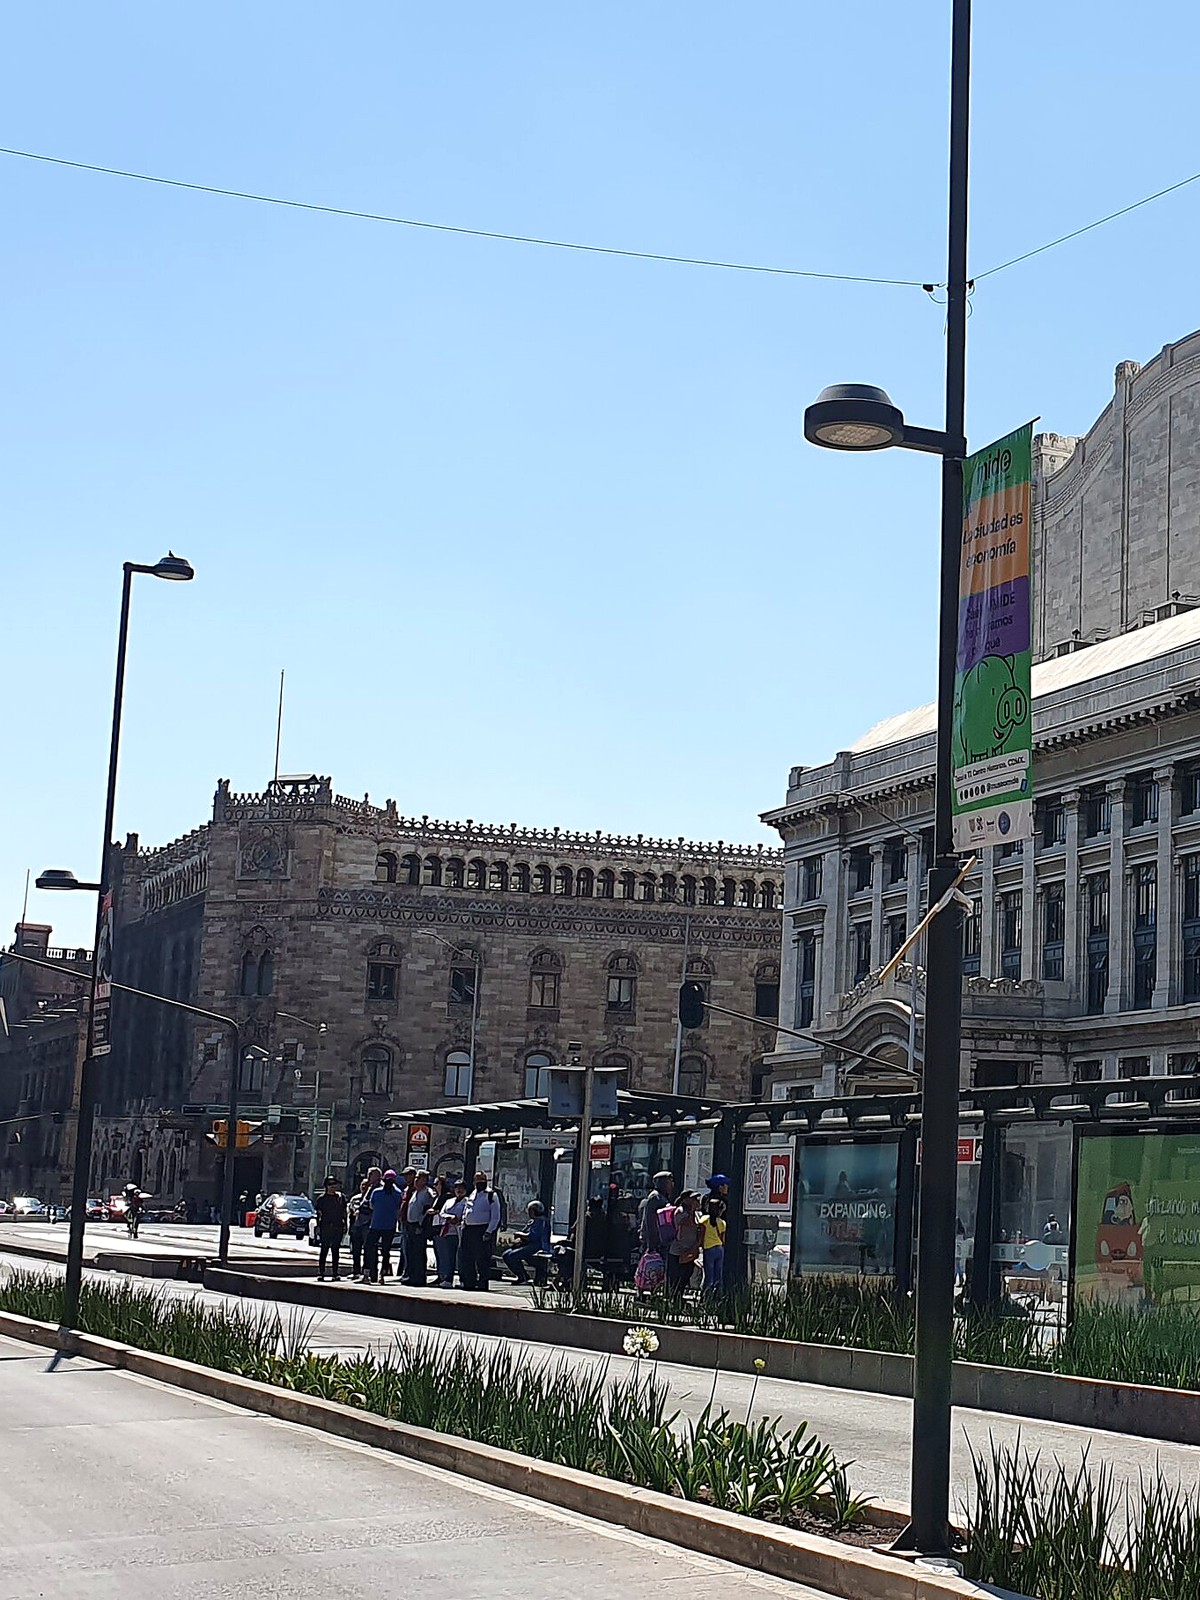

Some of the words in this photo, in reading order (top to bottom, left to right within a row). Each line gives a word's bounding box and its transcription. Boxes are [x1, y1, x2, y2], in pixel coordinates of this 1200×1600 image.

[974, 513, 1008, 540] ciudad
[1010, 512, 1023, 527] es
[966, 538, 1016, 568] economía
[820, 1202, 887, 1219] EXPANDING
